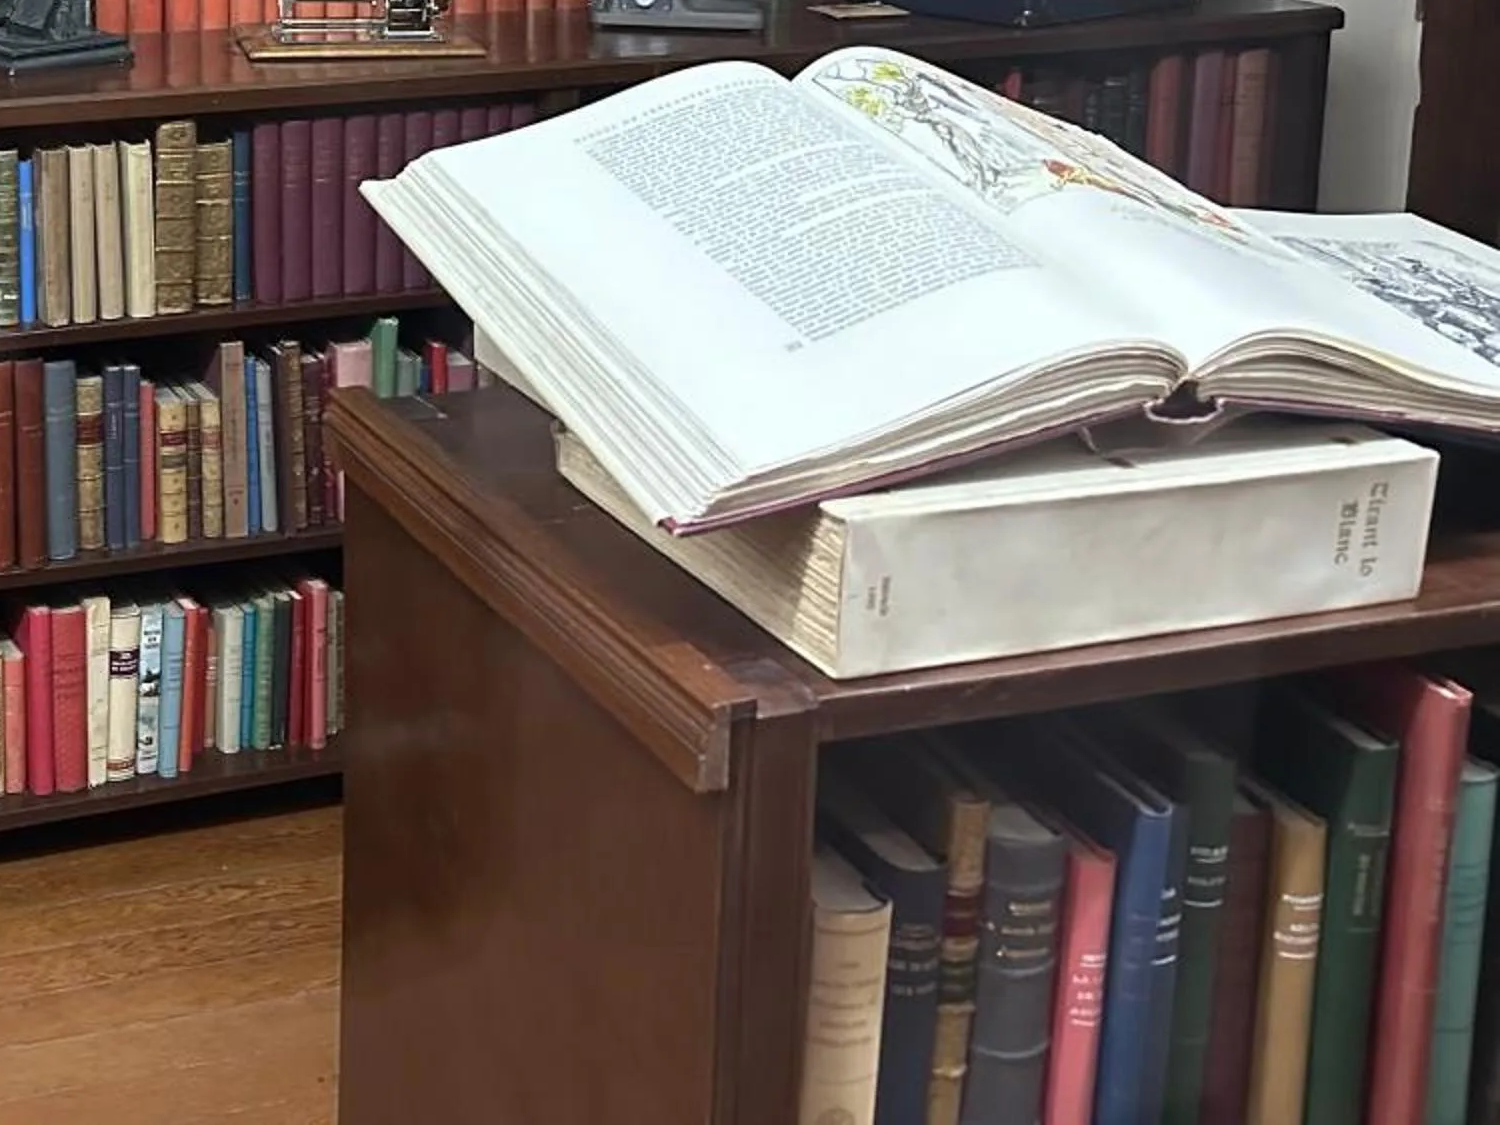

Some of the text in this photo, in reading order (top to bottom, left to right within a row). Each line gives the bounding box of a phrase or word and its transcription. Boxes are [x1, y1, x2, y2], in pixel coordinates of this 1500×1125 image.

[1334, 500, 1358, 565] Blanc
[1360, 482, 1389, 577] Tirant lo
